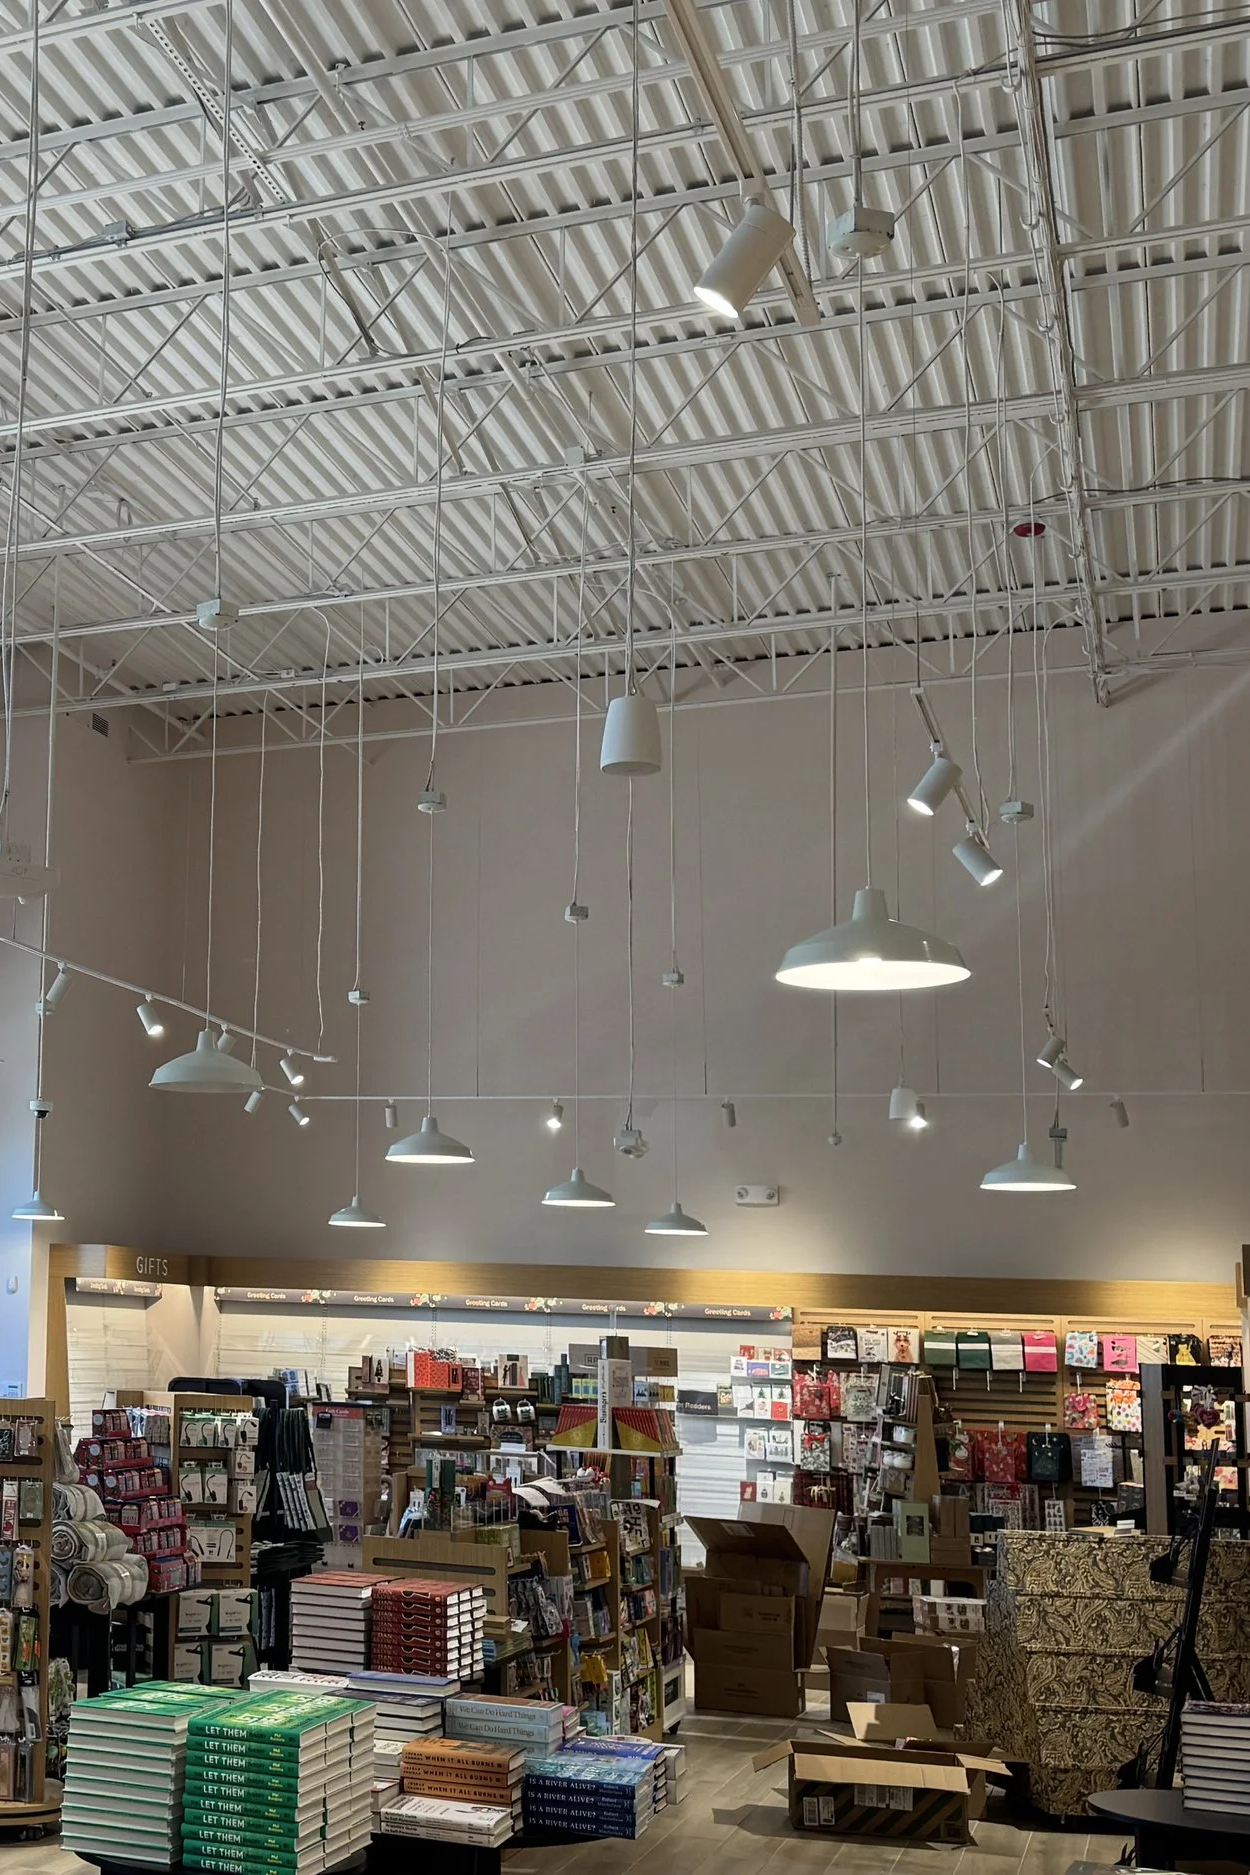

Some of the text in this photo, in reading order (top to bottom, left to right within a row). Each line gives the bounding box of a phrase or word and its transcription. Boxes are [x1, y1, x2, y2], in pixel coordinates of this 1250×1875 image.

[136, 1256, 168, 1276] GIFTS
[247, 1291, 269, 1300] Greeting
[353, 1295, 377, 1303] Greeting
[465, 1299, 508, 1308] Greeting Cards
[582, 1304, 607, 1312] Greeting
[705, 1307, 751, 1317] Greeting Cards
[685, 1402, 711, 1410] Readers
[460, 1705, 470, 1713] We
[471, 1707, 484, 1715] Can
[495, 1709, 512, 1718] Hard
[513, 1711, 535, 1720] Things
[206, 1726, 246, 1738] LET THEM
[459, 1722, 534, 1737] We Can Do Hard Things
[205, 1741, 245, 1753] LET THEM
[204, 1755, 245, 1767] LET THEM
[204, 1771, 245, 1783] LET THEM
[470, 1775, 492, 1783] BURNS
[545, 1779, 568, 1788] RIVER
[570, 1782, 596, 1790] ALIVE?
[204, 1785, 245, 1797] LET THEM
[474, 1791, 496, 1799] BURNS
[543, 1793, 566, 1801] RIVER
[568, 1796, 595, 1804] ALIVE?
[201, 1800, 242, 1813] LET THEM
[545, 1807, 568, 1815] RIVER
[570, 1809, 596, 1818] ALIVE?
[203, 1815, 244, 1828] LET THEM
[545, 1820, 568, 1828] RIVER
[569, 1822, 596, 1831] ALIVE?
[199, 1830, 240, 1843] LET THEM
[202, 1846, 243, 1858] LET THEM
[201, 1860, 242, 1873] LET THEM
